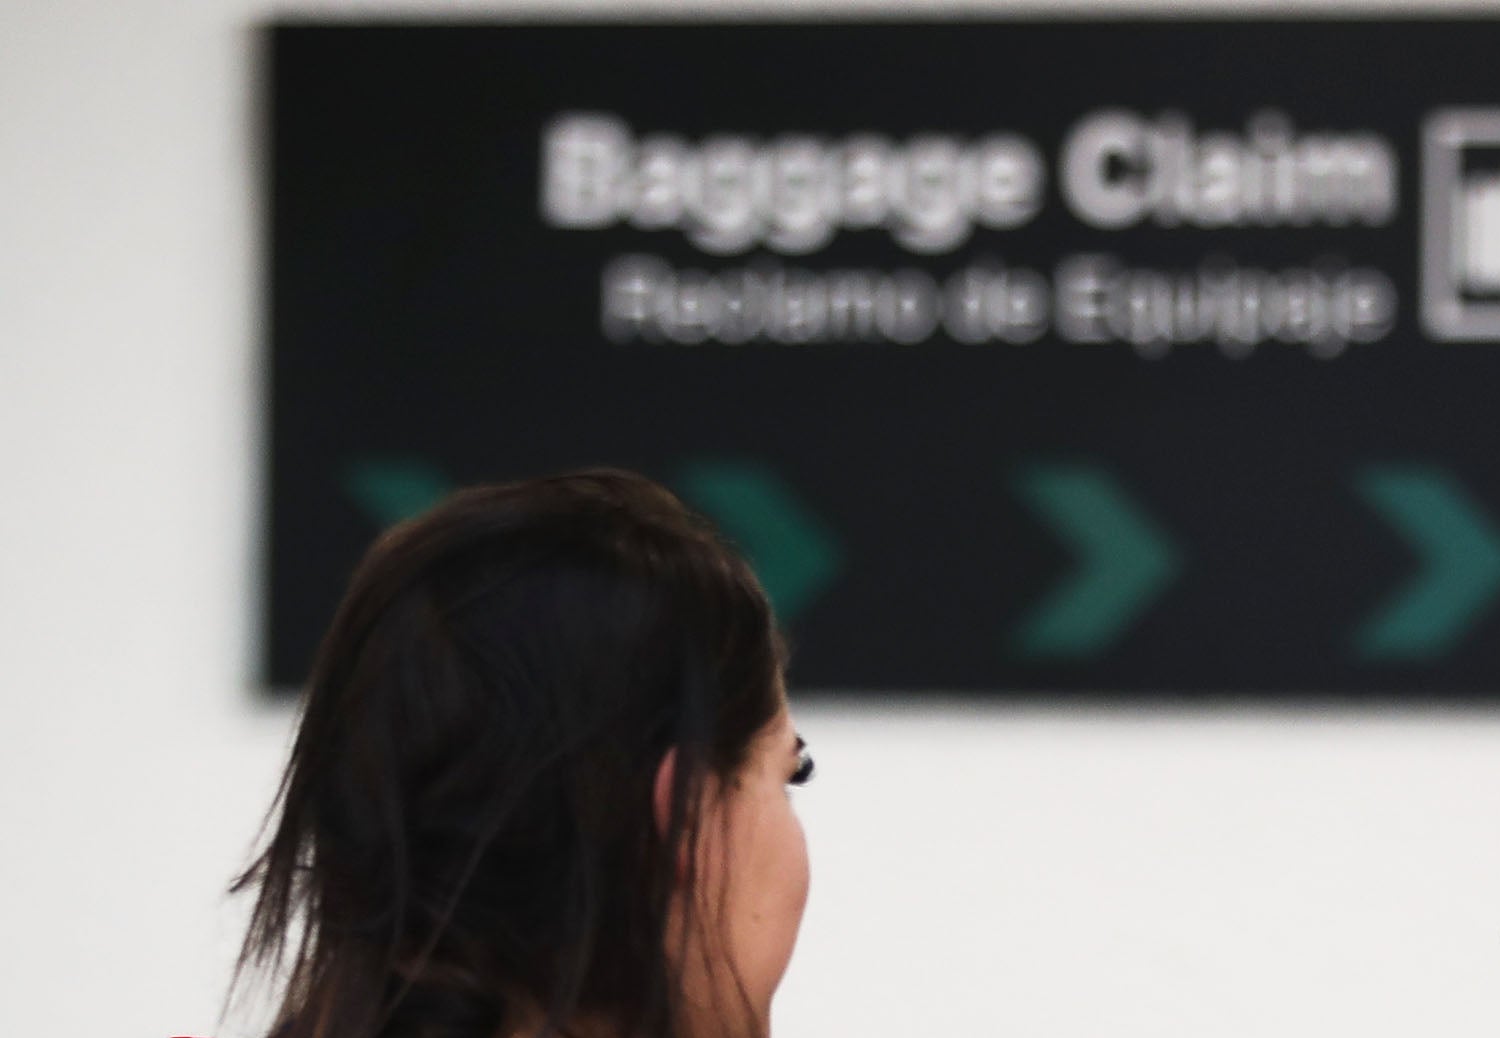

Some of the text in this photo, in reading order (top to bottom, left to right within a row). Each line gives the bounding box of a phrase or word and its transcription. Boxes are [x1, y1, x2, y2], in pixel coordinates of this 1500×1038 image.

[542, 109, 1393, 254] Baggage Claim
[604, 254, 1395, 359] Reclamo de Equipaje
